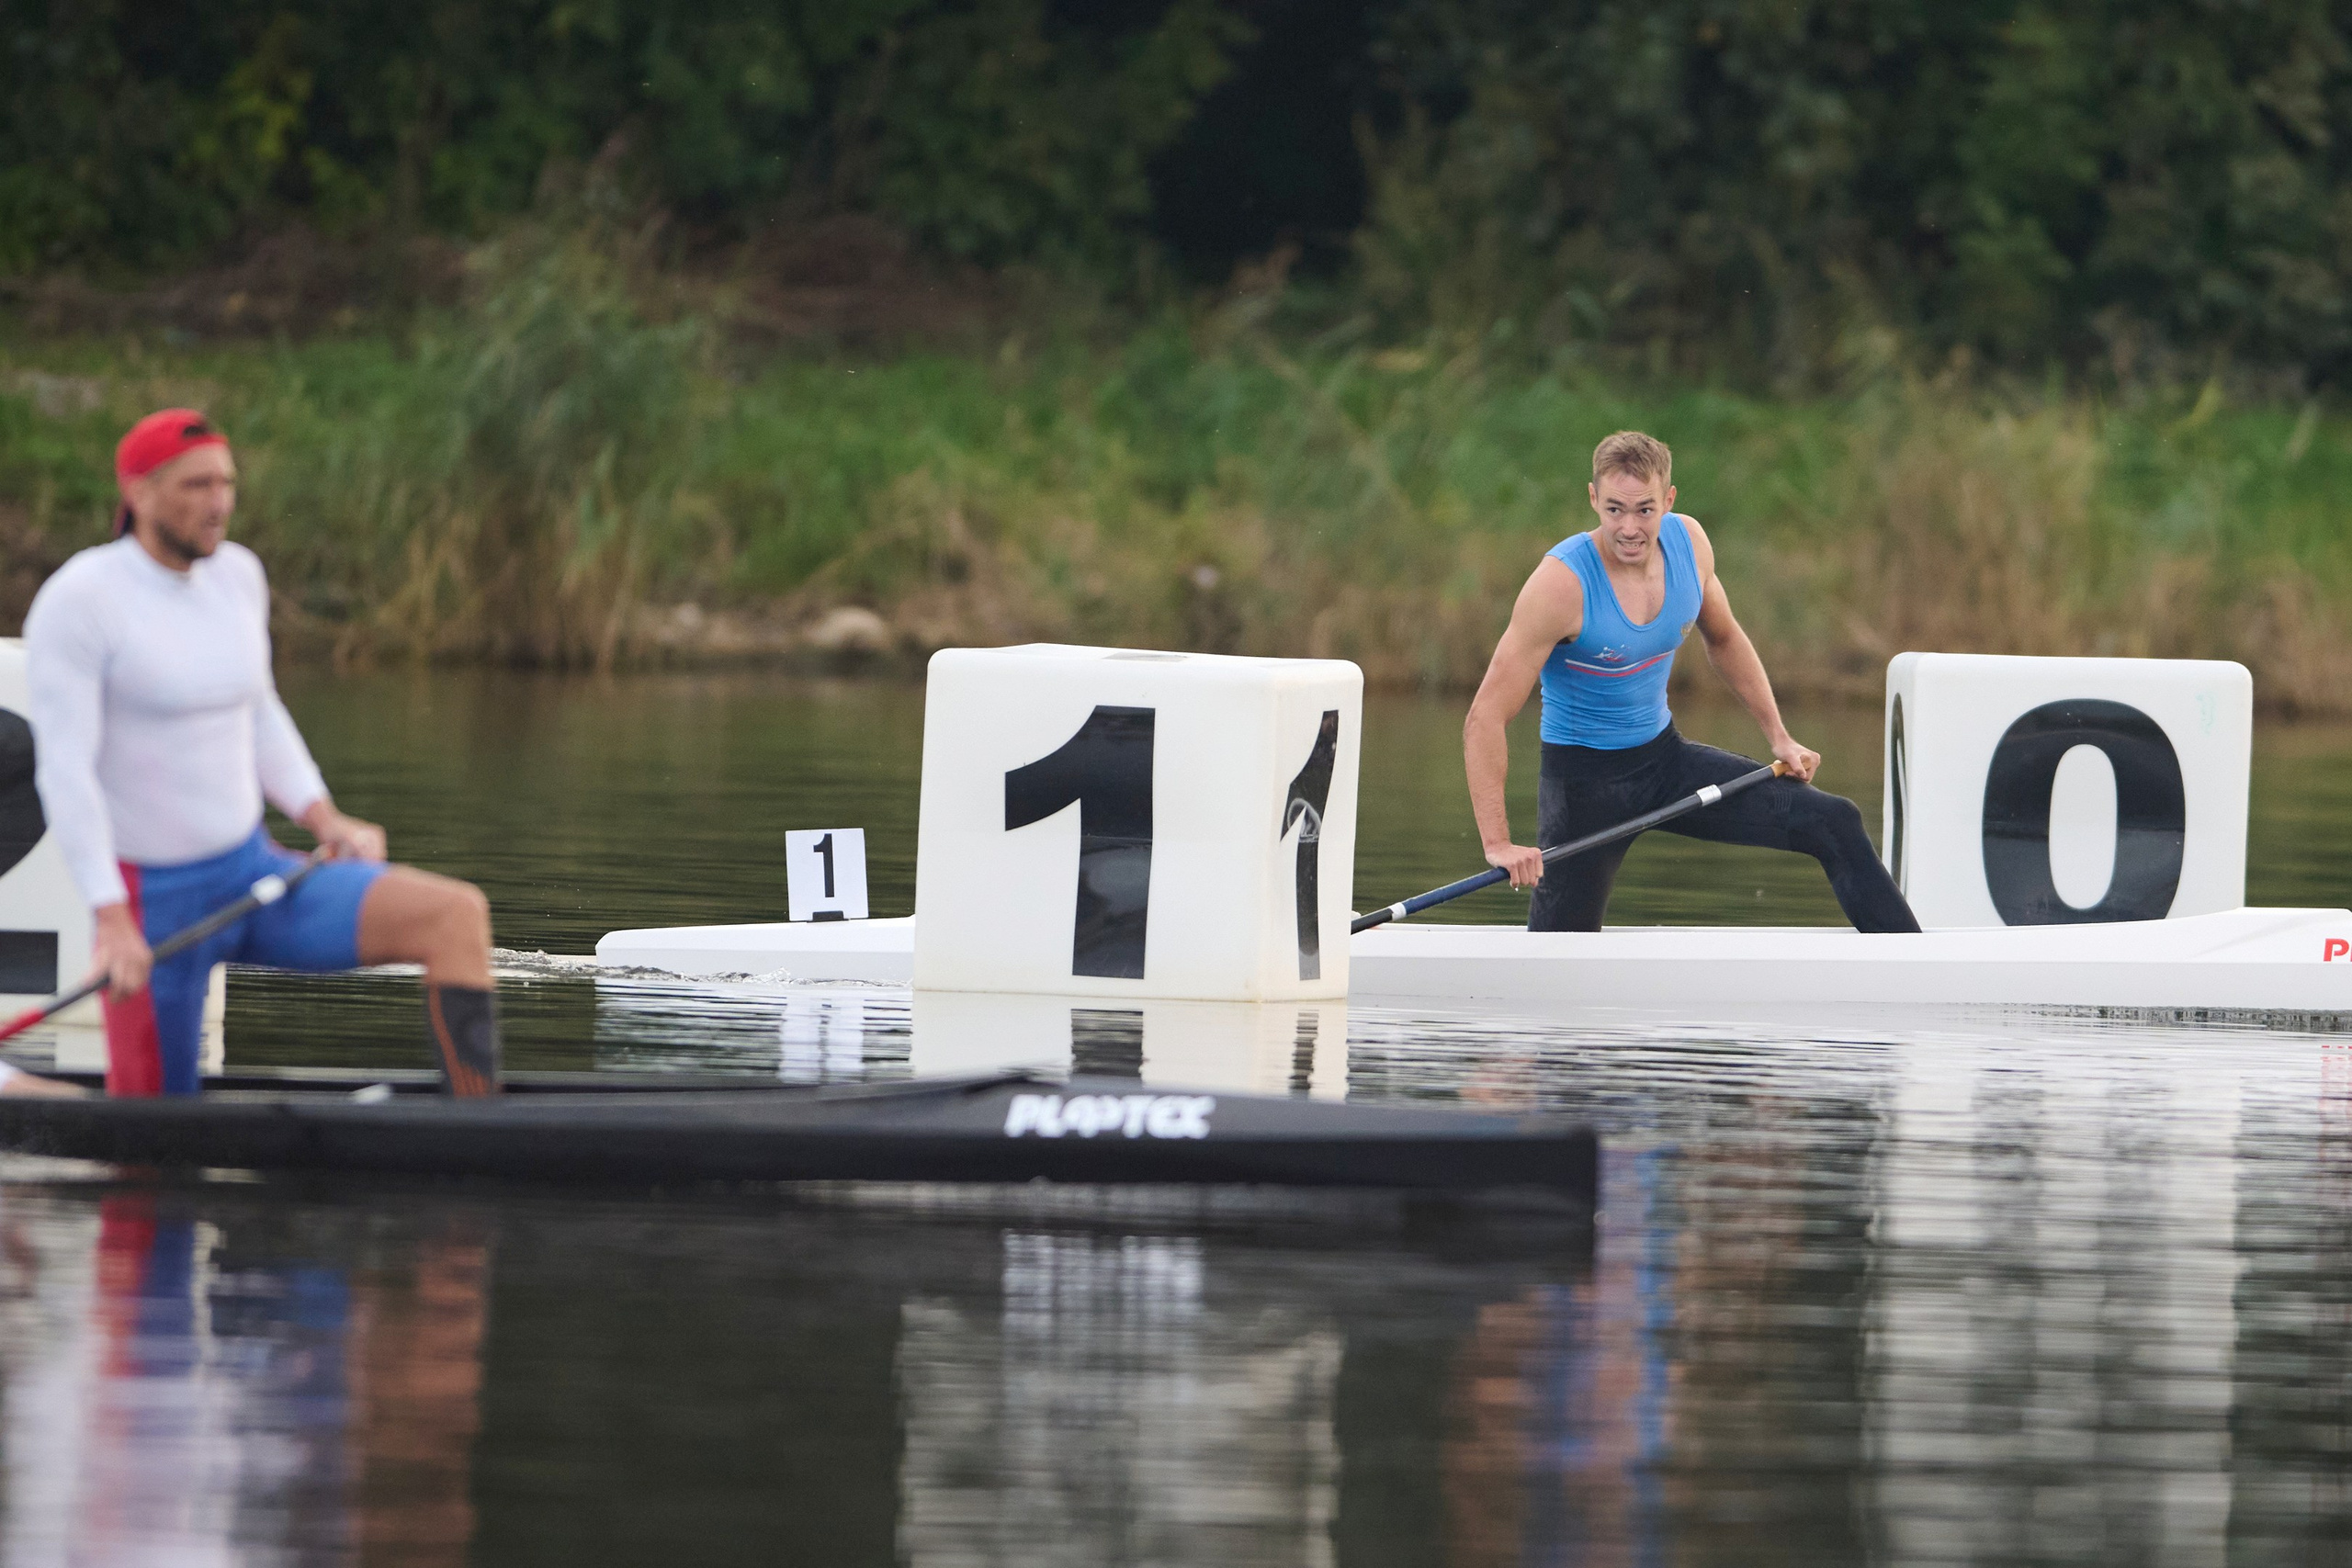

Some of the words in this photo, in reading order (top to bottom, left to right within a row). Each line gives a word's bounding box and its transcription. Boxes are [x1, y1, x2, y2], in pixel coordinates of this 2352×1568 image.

[813, 833, 835, 897] 1
[1004, 705, 1155, 979] 1
[1280, 709, 1339, 981] 1
[1982, 698, 2186, 926] 0
[2324, 938, 2352, 962] P
